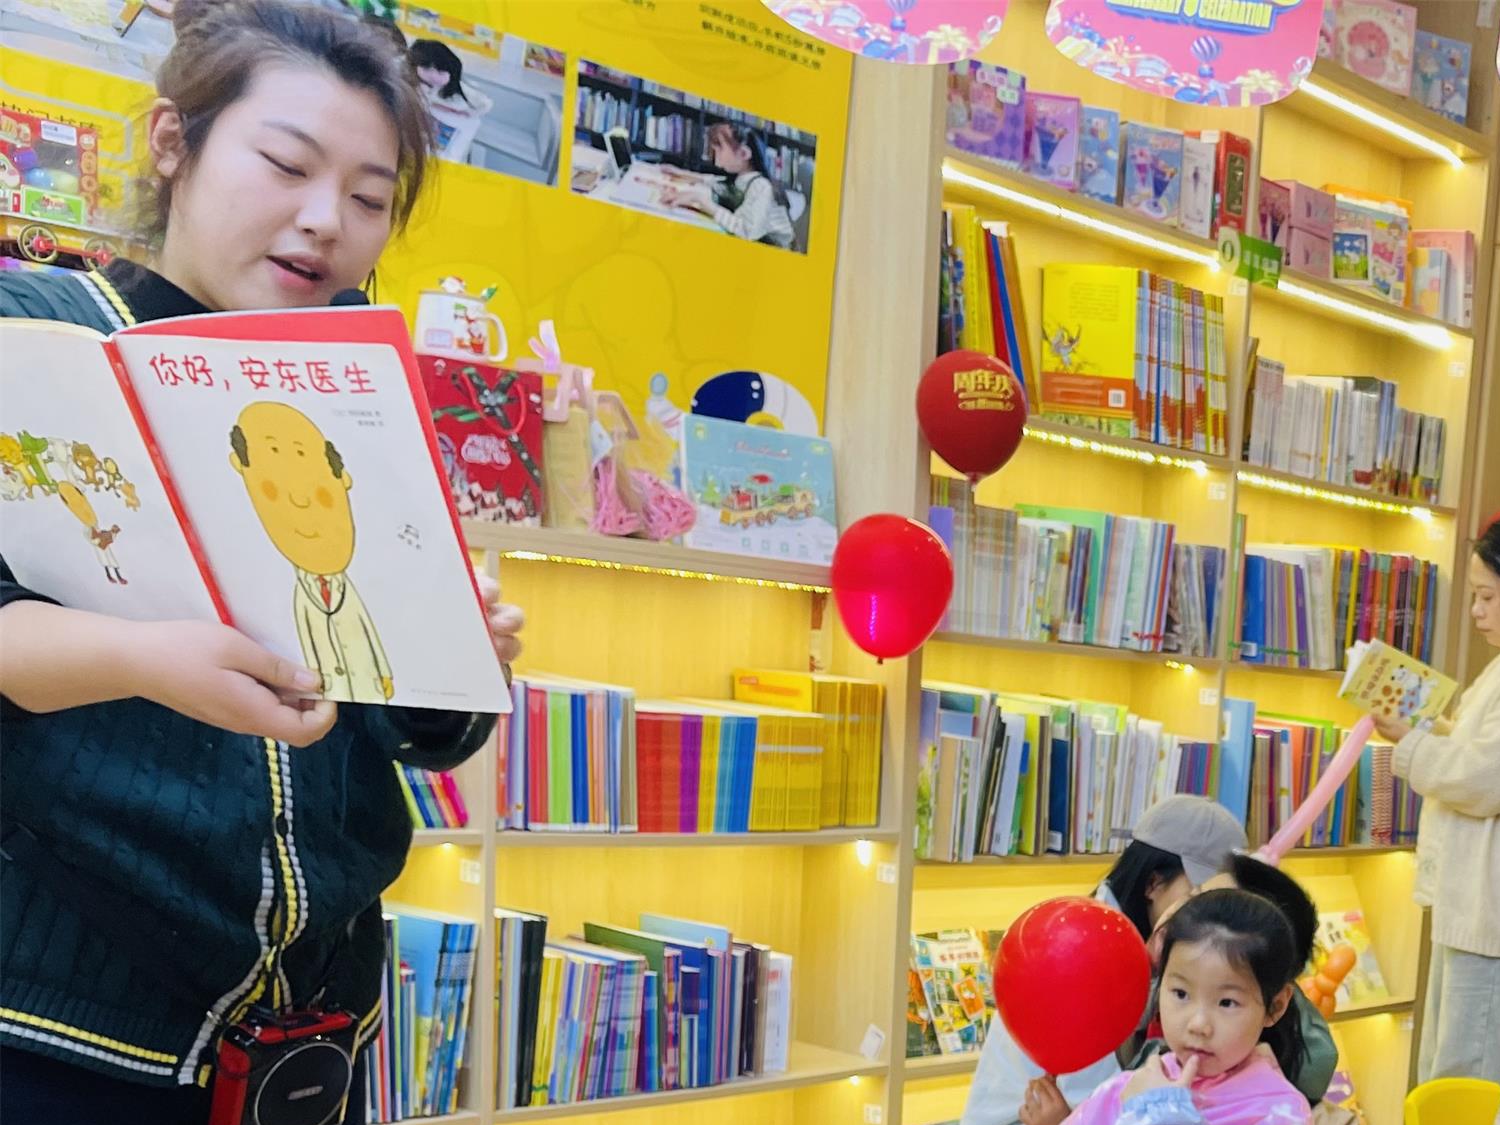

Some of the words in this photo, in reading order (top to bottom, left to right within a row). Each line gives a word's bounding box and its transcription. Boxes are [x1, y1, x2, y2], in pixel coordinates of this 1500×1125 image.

[149, 352, 377, 394] 你好，安东医生
